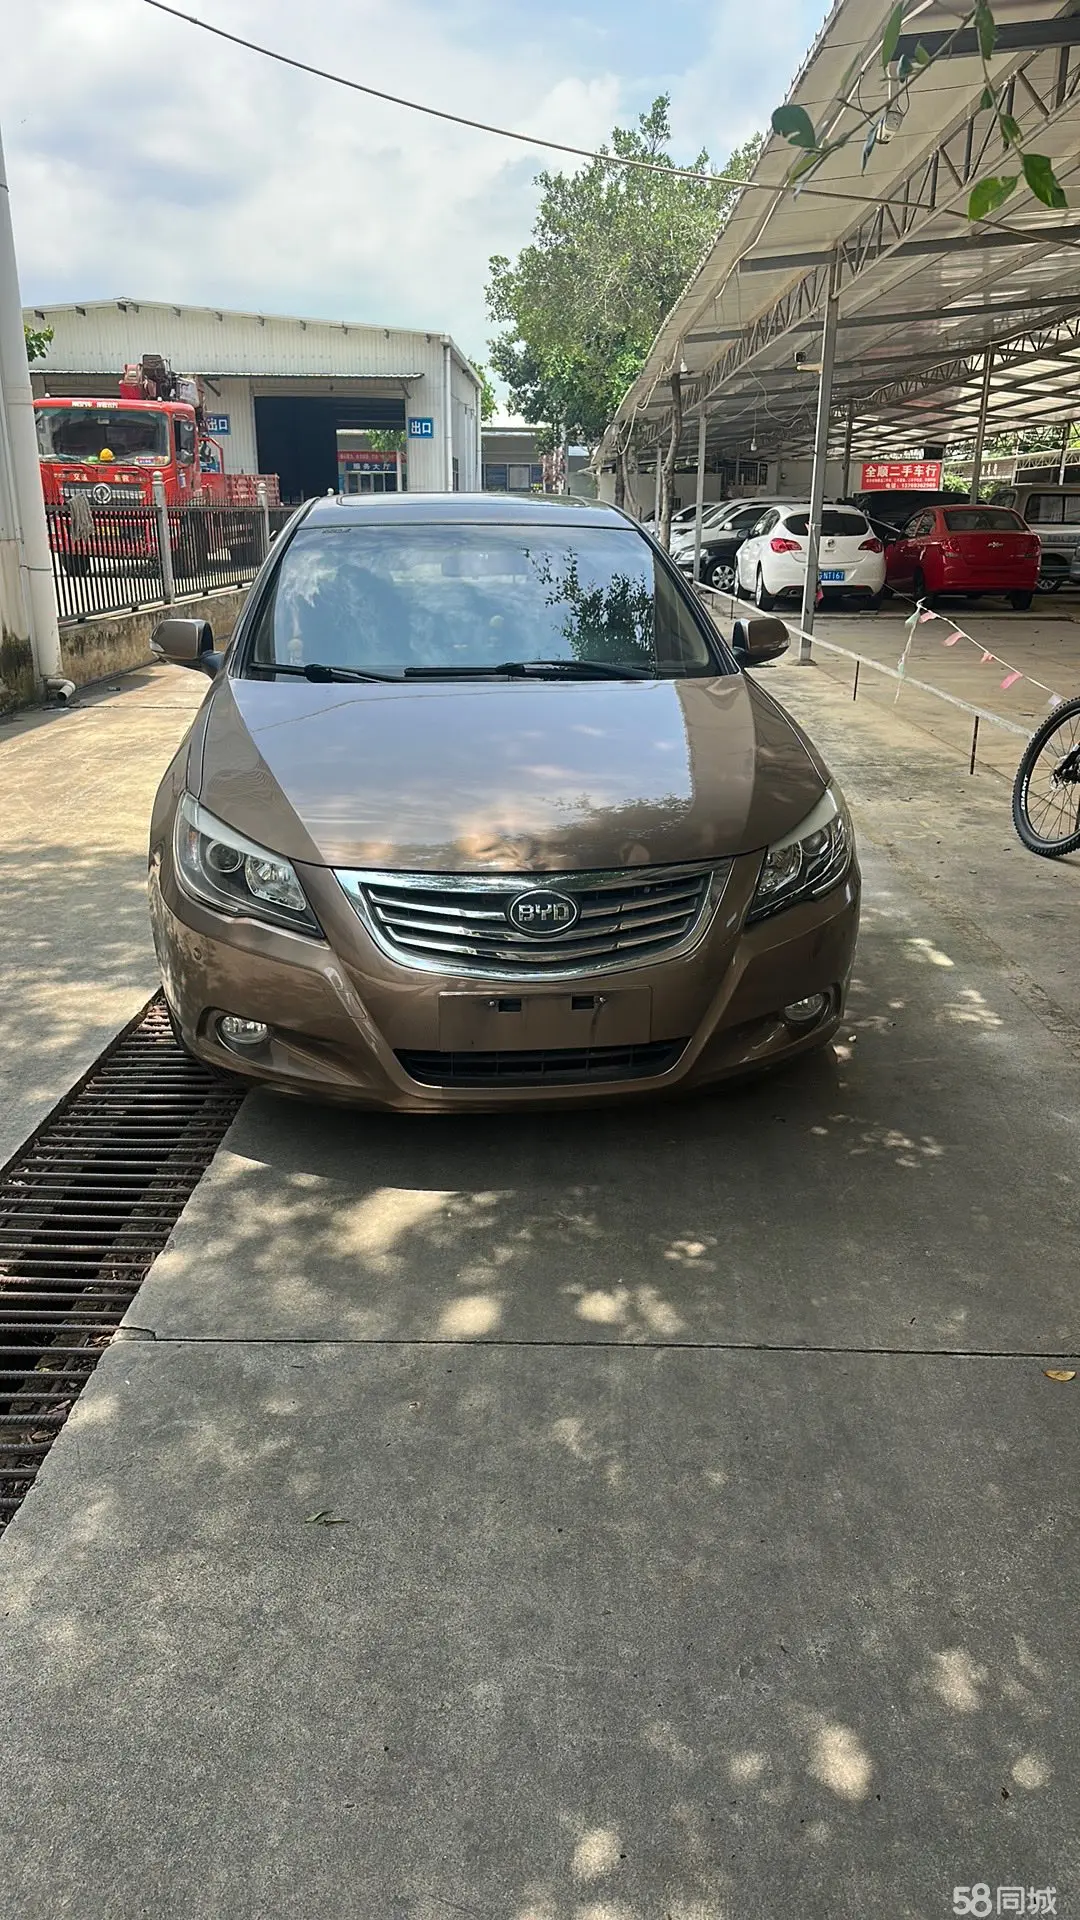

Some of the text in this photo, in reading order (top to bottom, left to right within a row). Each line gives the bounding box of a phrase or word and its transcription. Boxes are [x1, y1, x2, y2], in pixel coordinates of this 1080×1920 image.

[207, 417, 228, 431] 出口
[411, 420, 431, 435] 出口
[865, 465, 938, 477] 全顺二手车行
[518, 903, 570, 921] BYD
